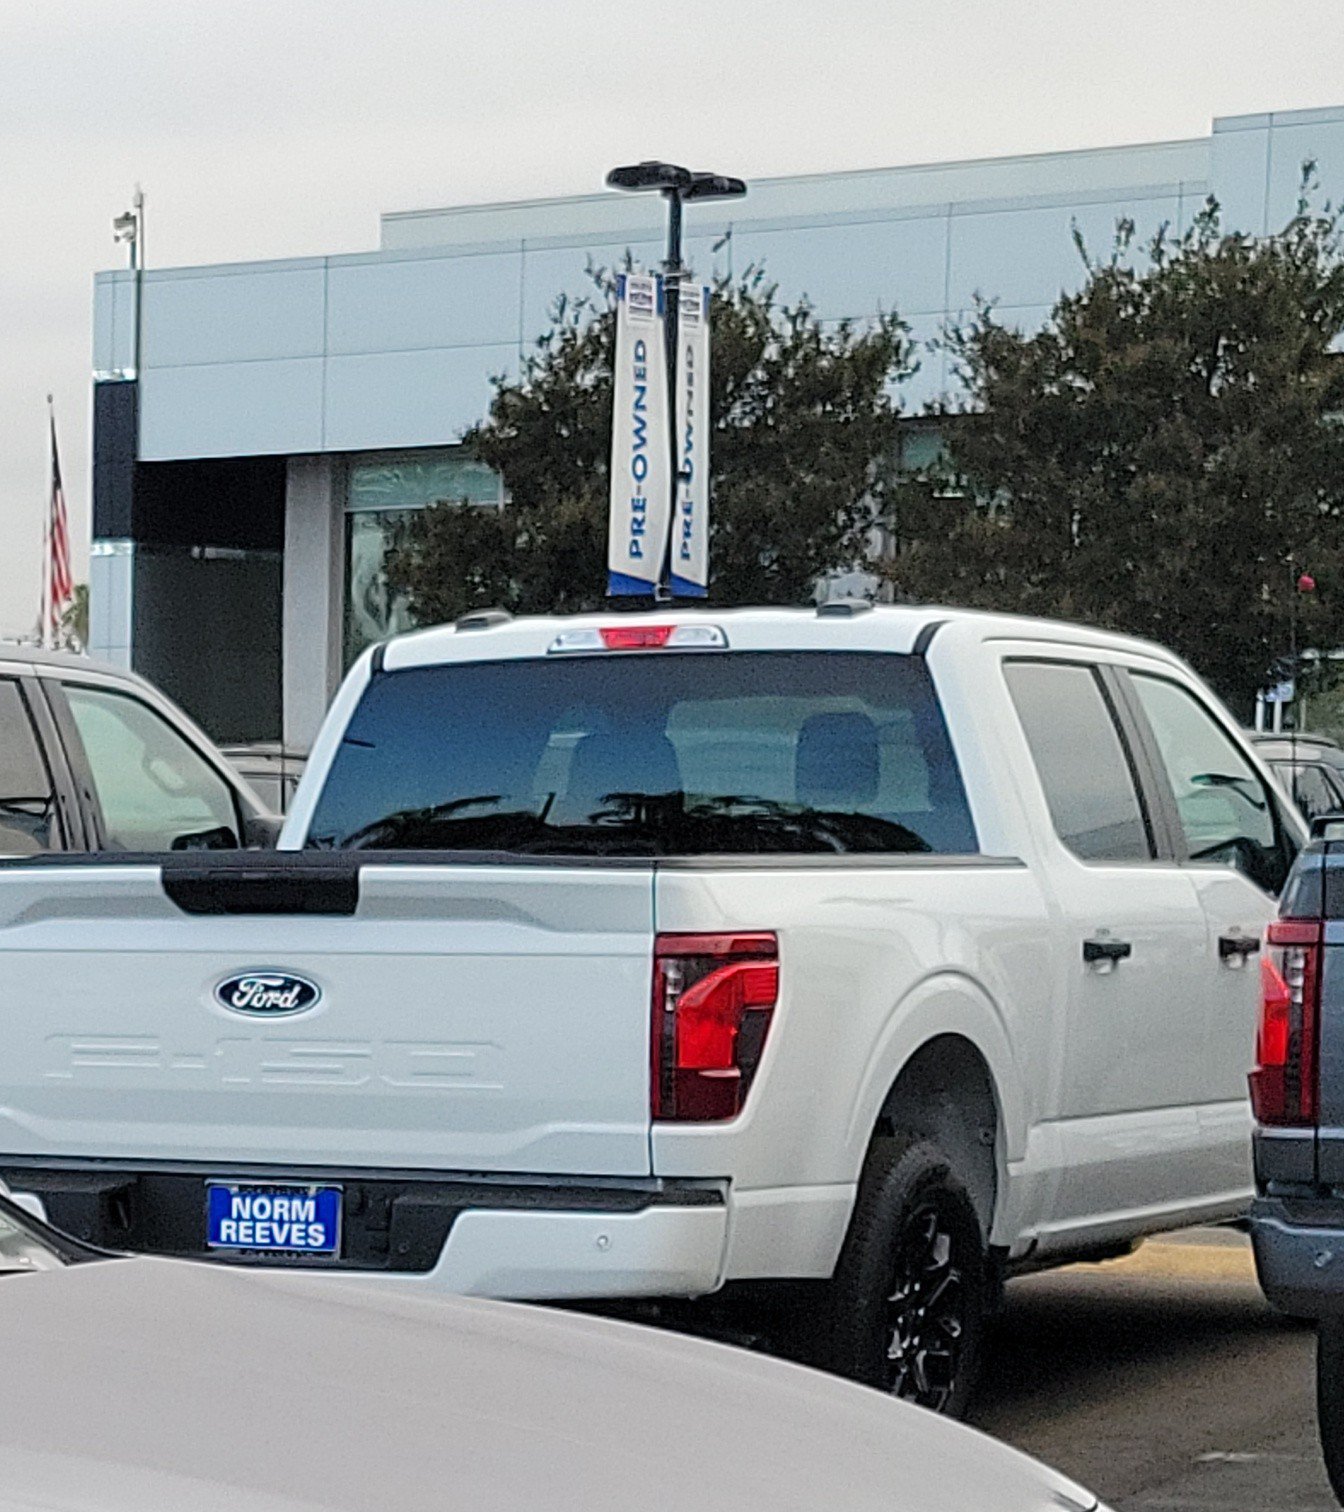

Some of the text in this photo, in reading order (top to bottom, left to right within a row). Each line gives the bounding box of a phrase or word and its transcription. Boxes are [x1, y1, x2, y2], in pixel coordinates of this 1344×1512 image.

[629, 338, 649, 560] PRE-OWNED
[680, 344, 695, 561] PRE-OWNED
[230, 975, 302, 1011] Ford
[231, 1196, 316, 1223] NORM
[220, 1218, 326, 1247] REEVES
